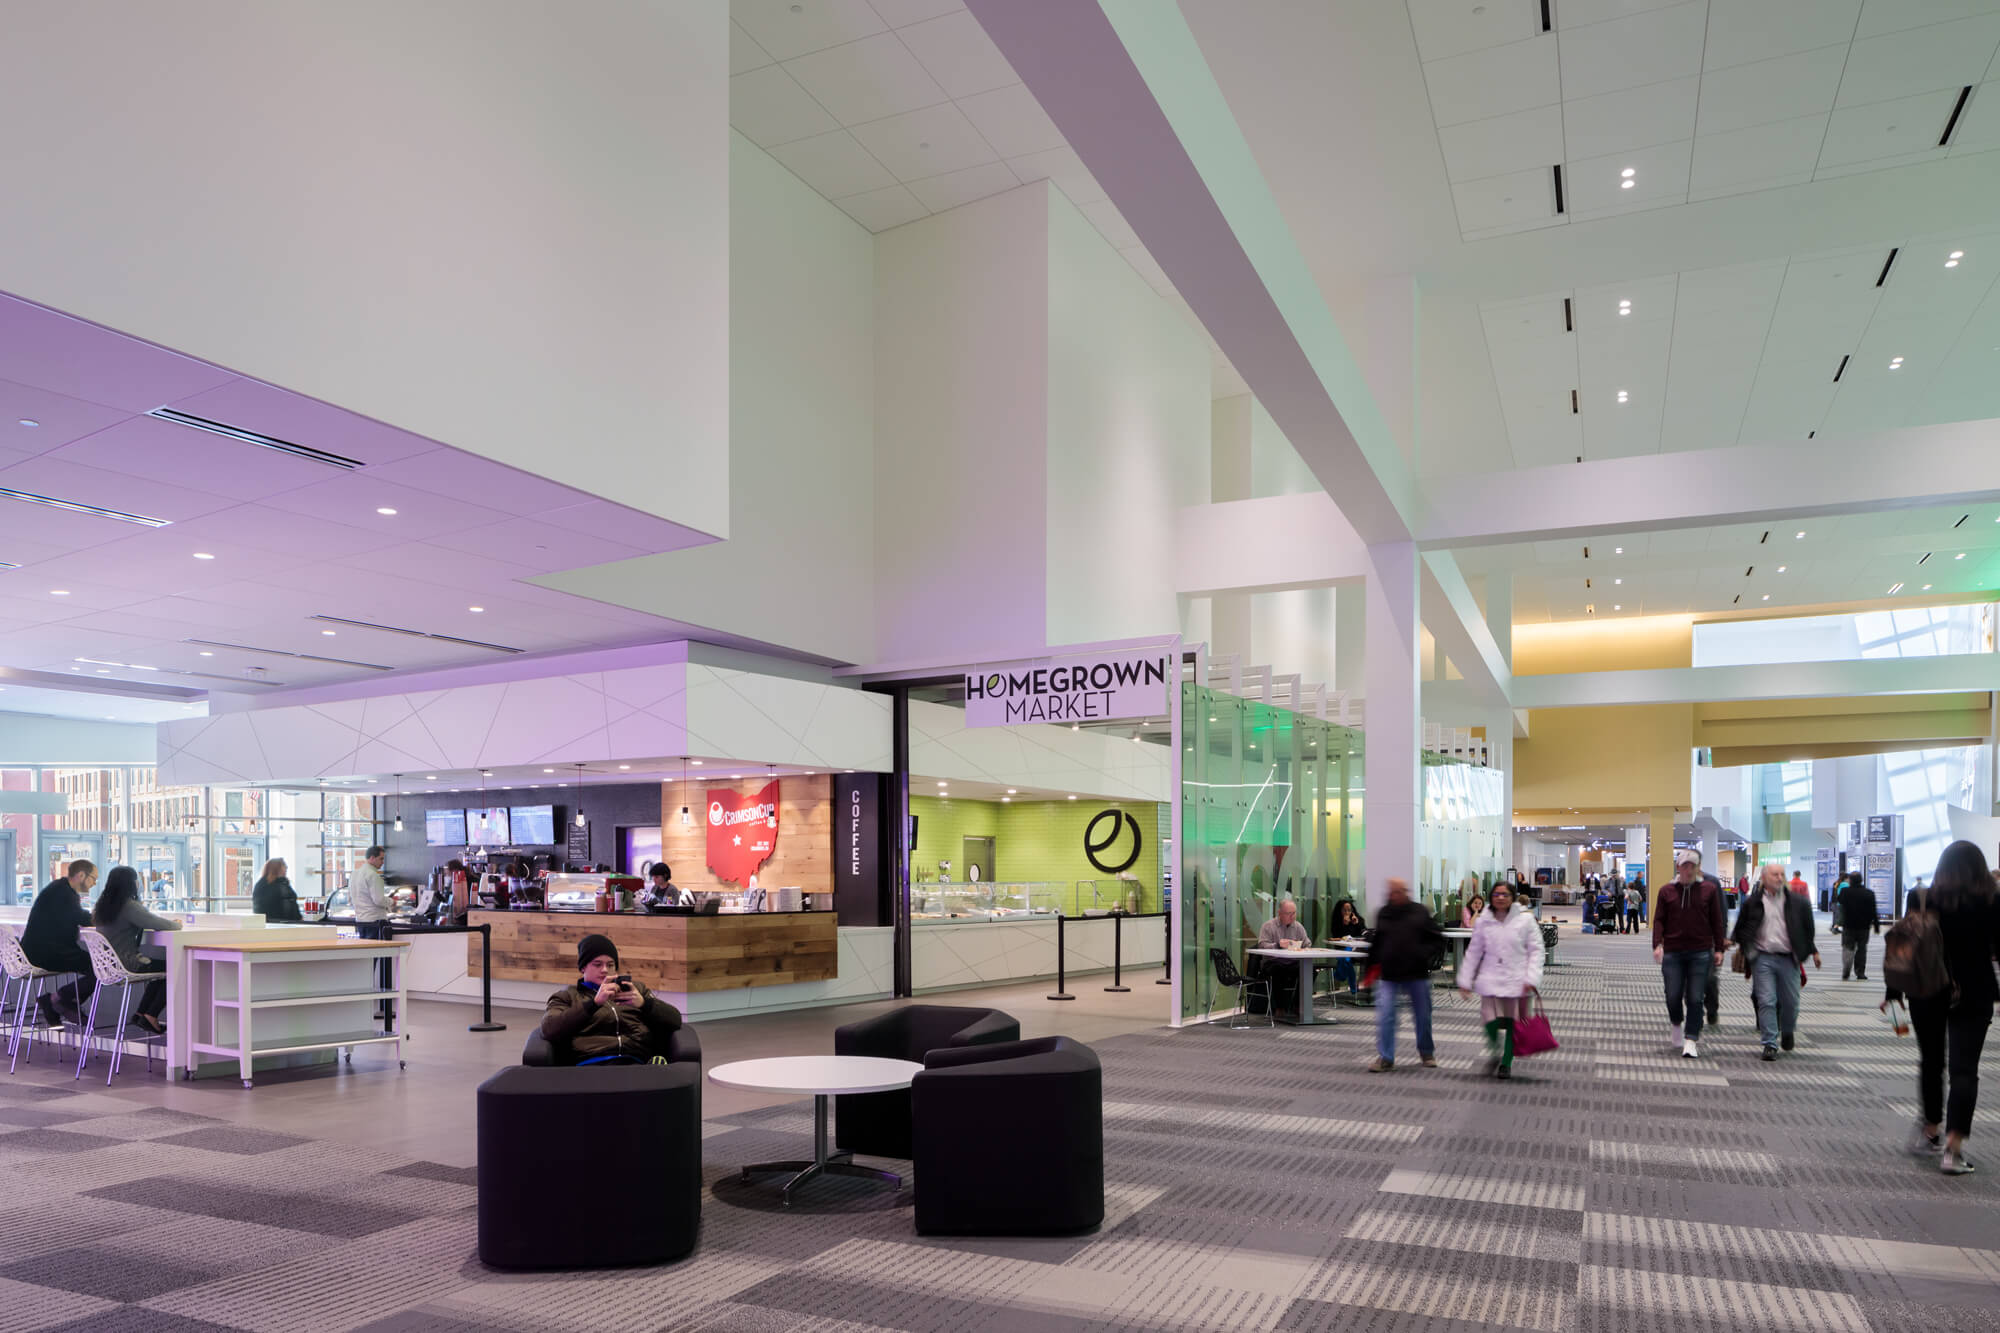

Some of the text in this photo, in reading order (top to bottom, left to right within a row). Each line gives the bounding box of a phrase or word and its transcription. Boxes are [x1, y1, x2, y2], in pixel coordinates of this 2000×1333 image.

[967, 658, 1165, 700] HOMEGROWN
[1006, 690, 1116, 723] MARKET
[852, 790, 860, 875] COFFEE
